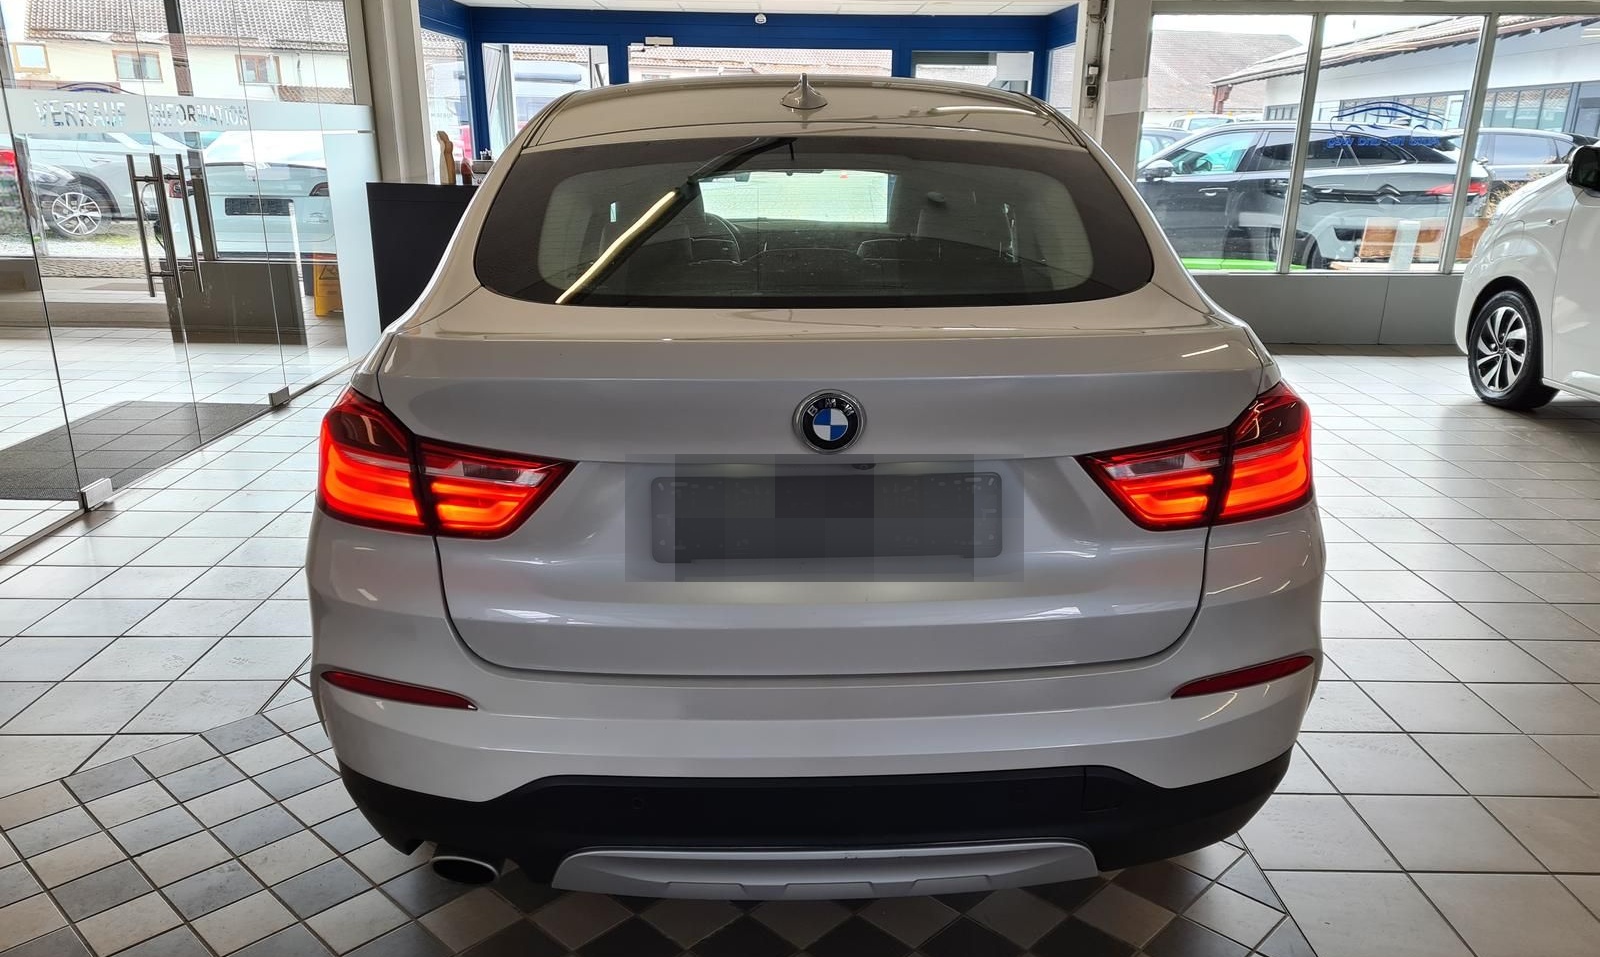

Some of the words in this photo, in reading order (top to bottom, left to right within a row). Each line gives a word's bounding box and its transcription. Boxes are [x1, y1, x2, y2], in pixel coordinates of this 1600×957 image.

[33, 98, 126, 126] VERKAUF
[148, 102, 249, 126] INFORMATION
[808, 398, 854, 417] BMW
